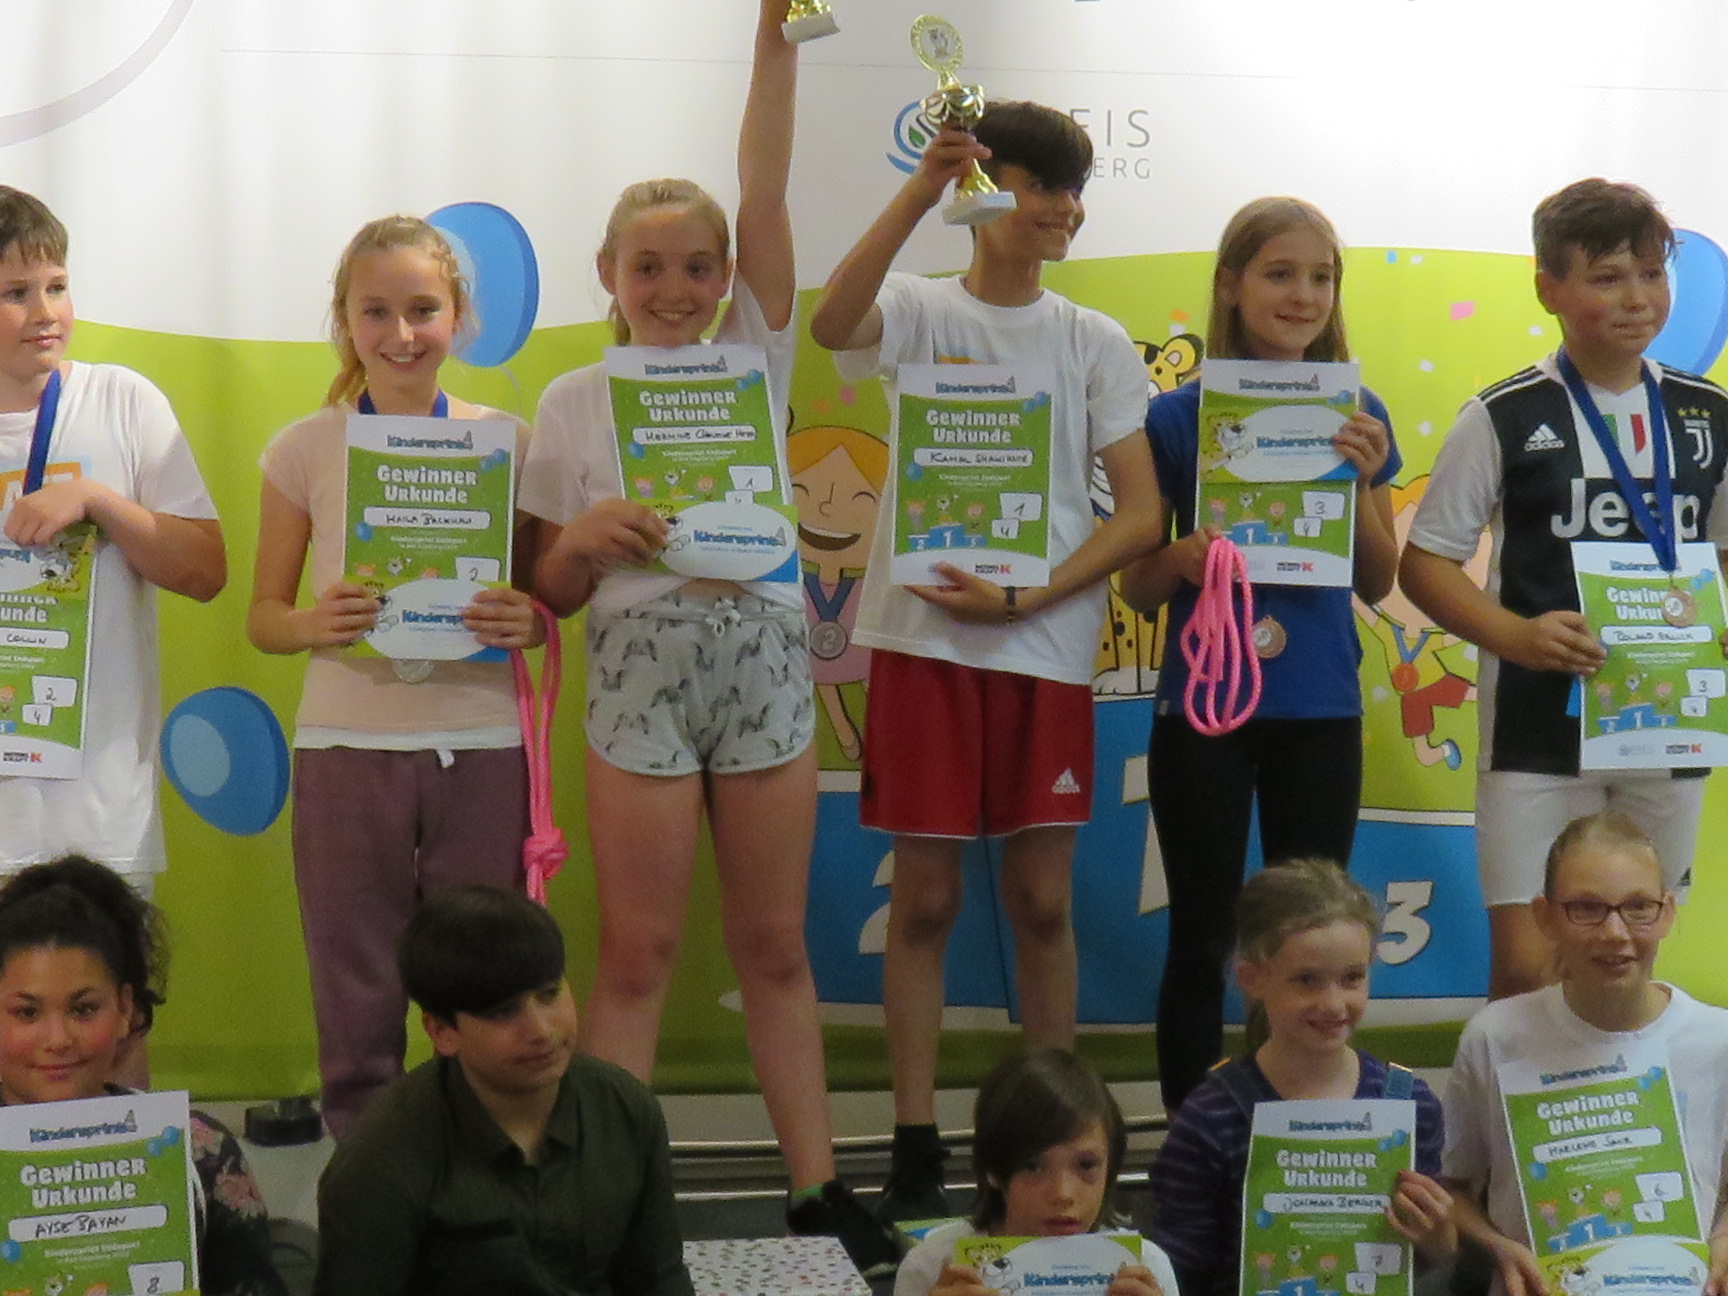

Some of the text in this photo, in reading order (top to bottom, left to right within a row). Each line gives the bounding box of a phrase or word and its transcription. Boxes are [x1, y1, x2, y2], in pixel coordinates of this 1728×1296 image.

[1524, 439, 1565, 452] adidas
[822, 628, 835, 649] 2
[1375, 880, 1433, 966] 3
